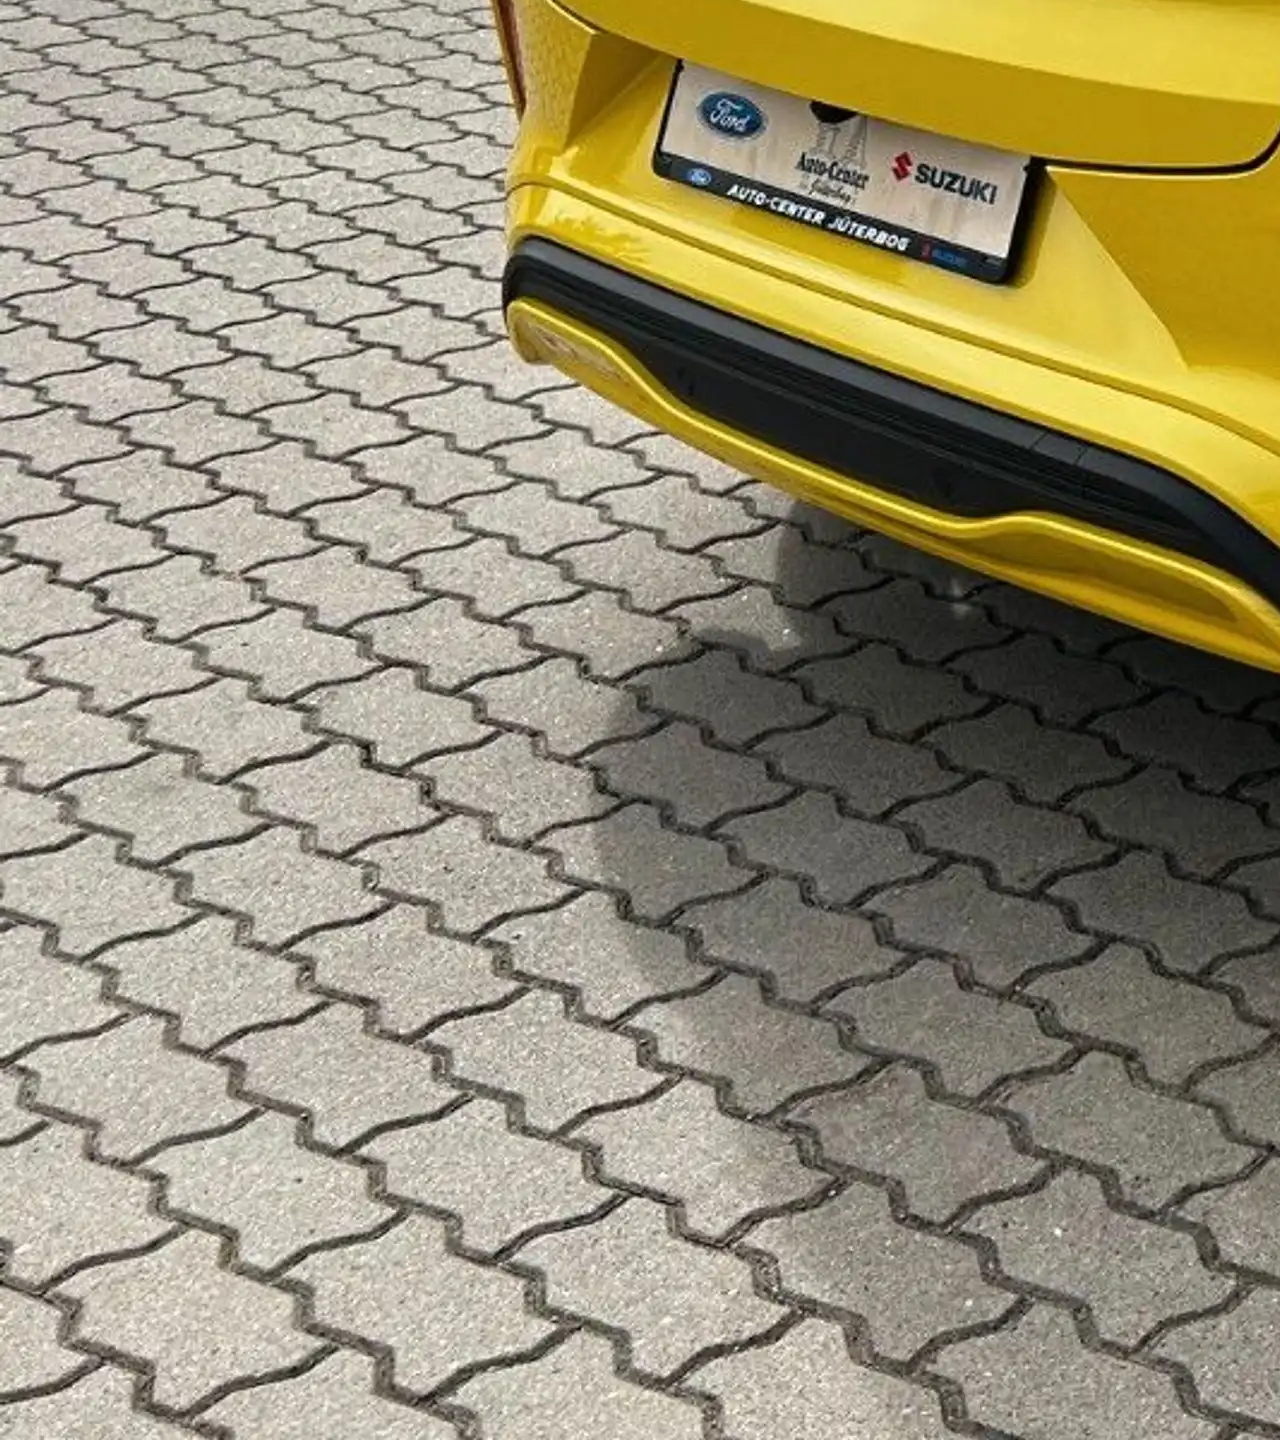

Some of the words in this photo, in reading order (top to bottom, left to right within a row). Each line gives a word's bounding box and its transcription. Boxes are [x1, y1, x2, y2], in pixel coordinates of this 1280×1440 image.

[710, 98, 751, 133] Ford
[914, 163, 998, 206] SUZUKI
[727, 183, 825, 227] AUTO-CENTER
[827, 212, 910, 252] JÜTERBOG
